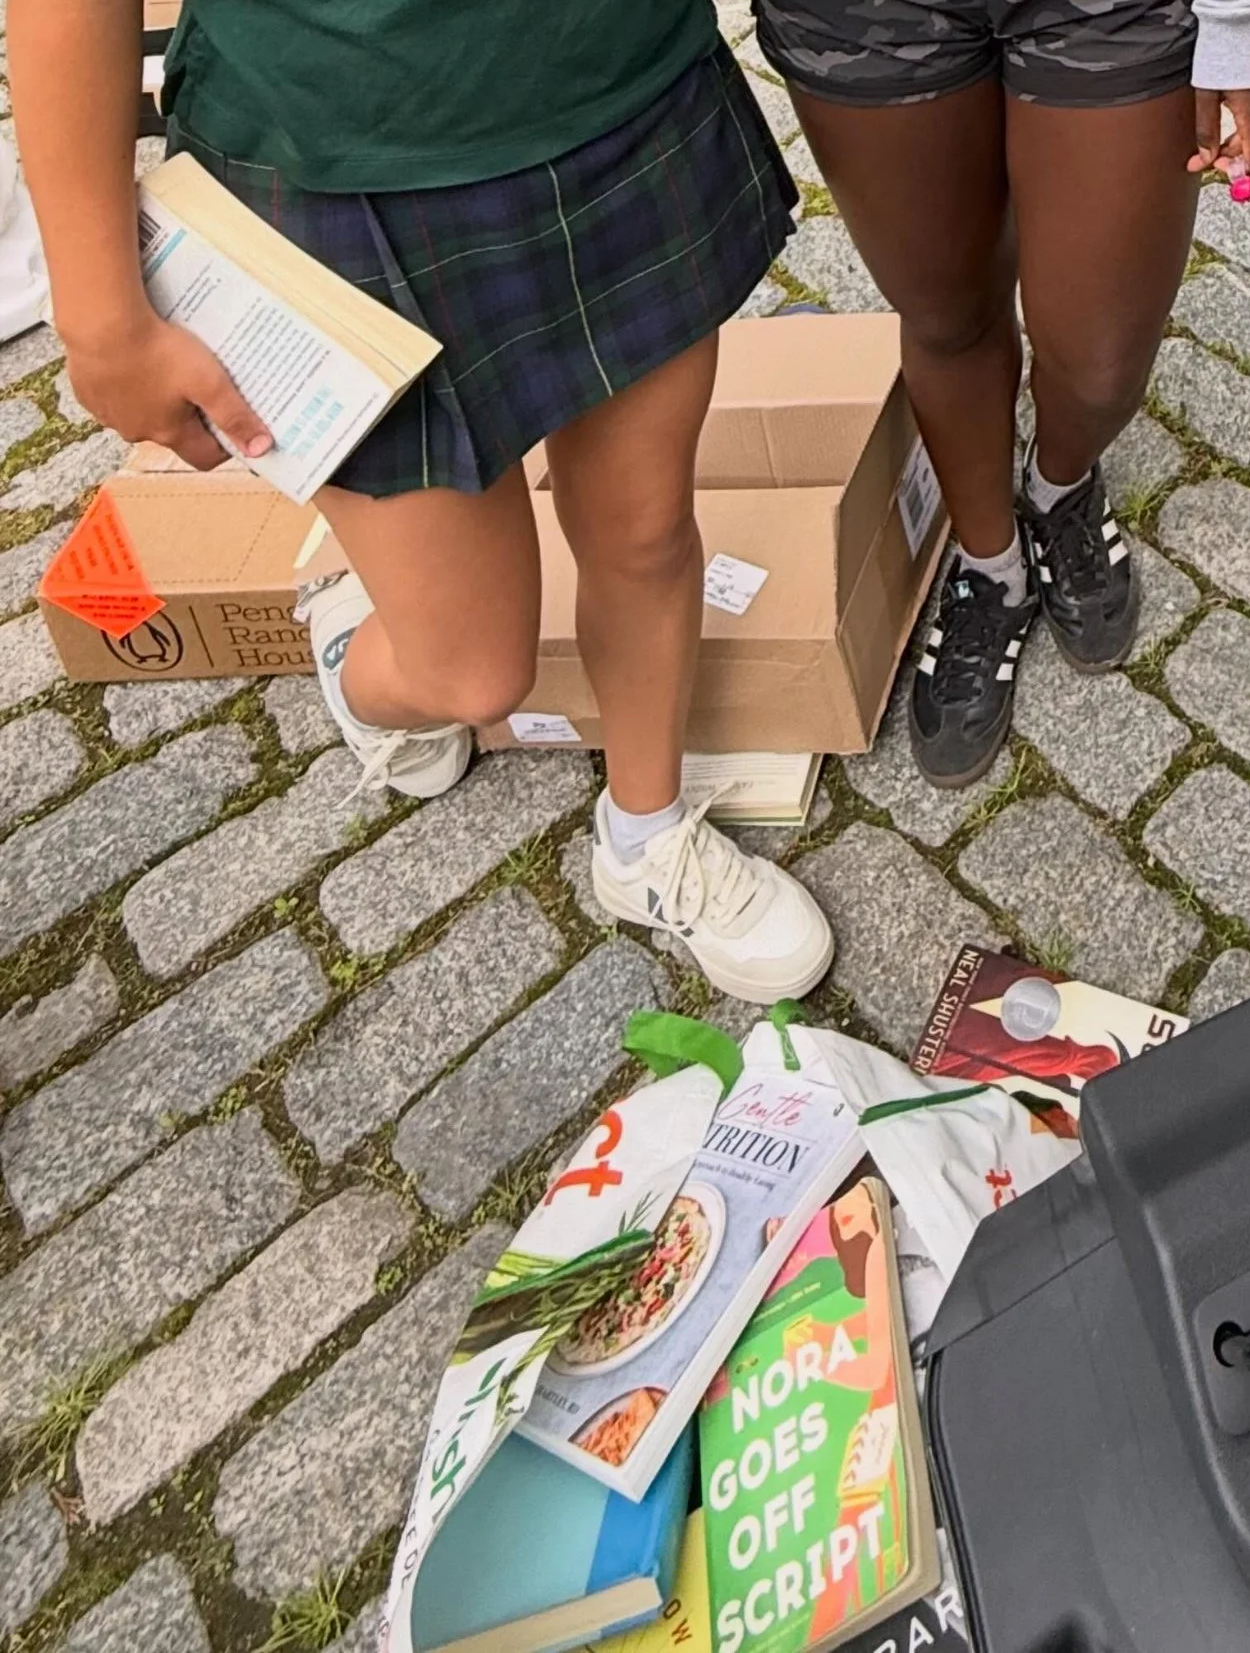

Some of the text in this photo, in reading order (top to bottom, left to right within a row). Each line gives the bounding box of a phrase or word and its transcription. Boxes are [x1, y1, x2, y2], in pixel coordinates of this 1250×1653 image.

[215, 603, 299, 624] Peng
[224, 626, 311, 645] Ran
[233, 648, 316, 667] Hous
[949, 948, 979, 987] NEAL
[717, 1083, 813, 1129] Gentle
[544, 1110, 624, 1207] ct
[702, 1122, 810, 1175] TRITION
[731, 1325, 858, 1434] NORA
[708, 1402, 829, 1512] GOES
[728, 1474, 816, 1571] OFF
[716, 1505, 885, 1653] SCRIPT
